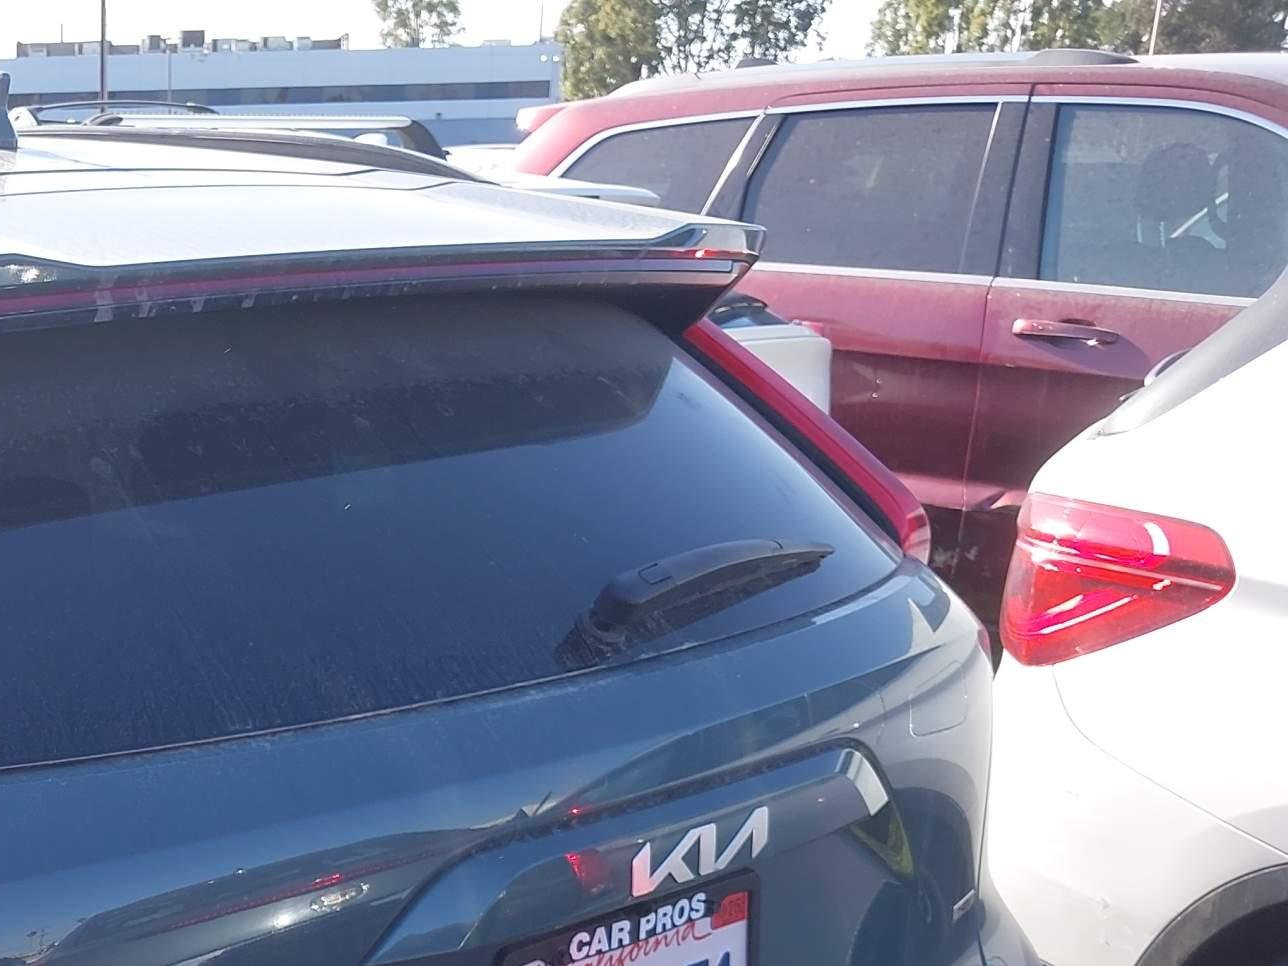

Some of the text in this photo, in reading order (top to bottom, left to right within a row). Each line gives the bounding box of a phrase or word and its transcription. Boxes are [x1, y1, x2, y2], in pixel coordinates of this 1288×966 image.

[632, 806, 769, 897] KIA
[569, 919, 632, 961] CAR
[638, 892, 707, 946] PROS
